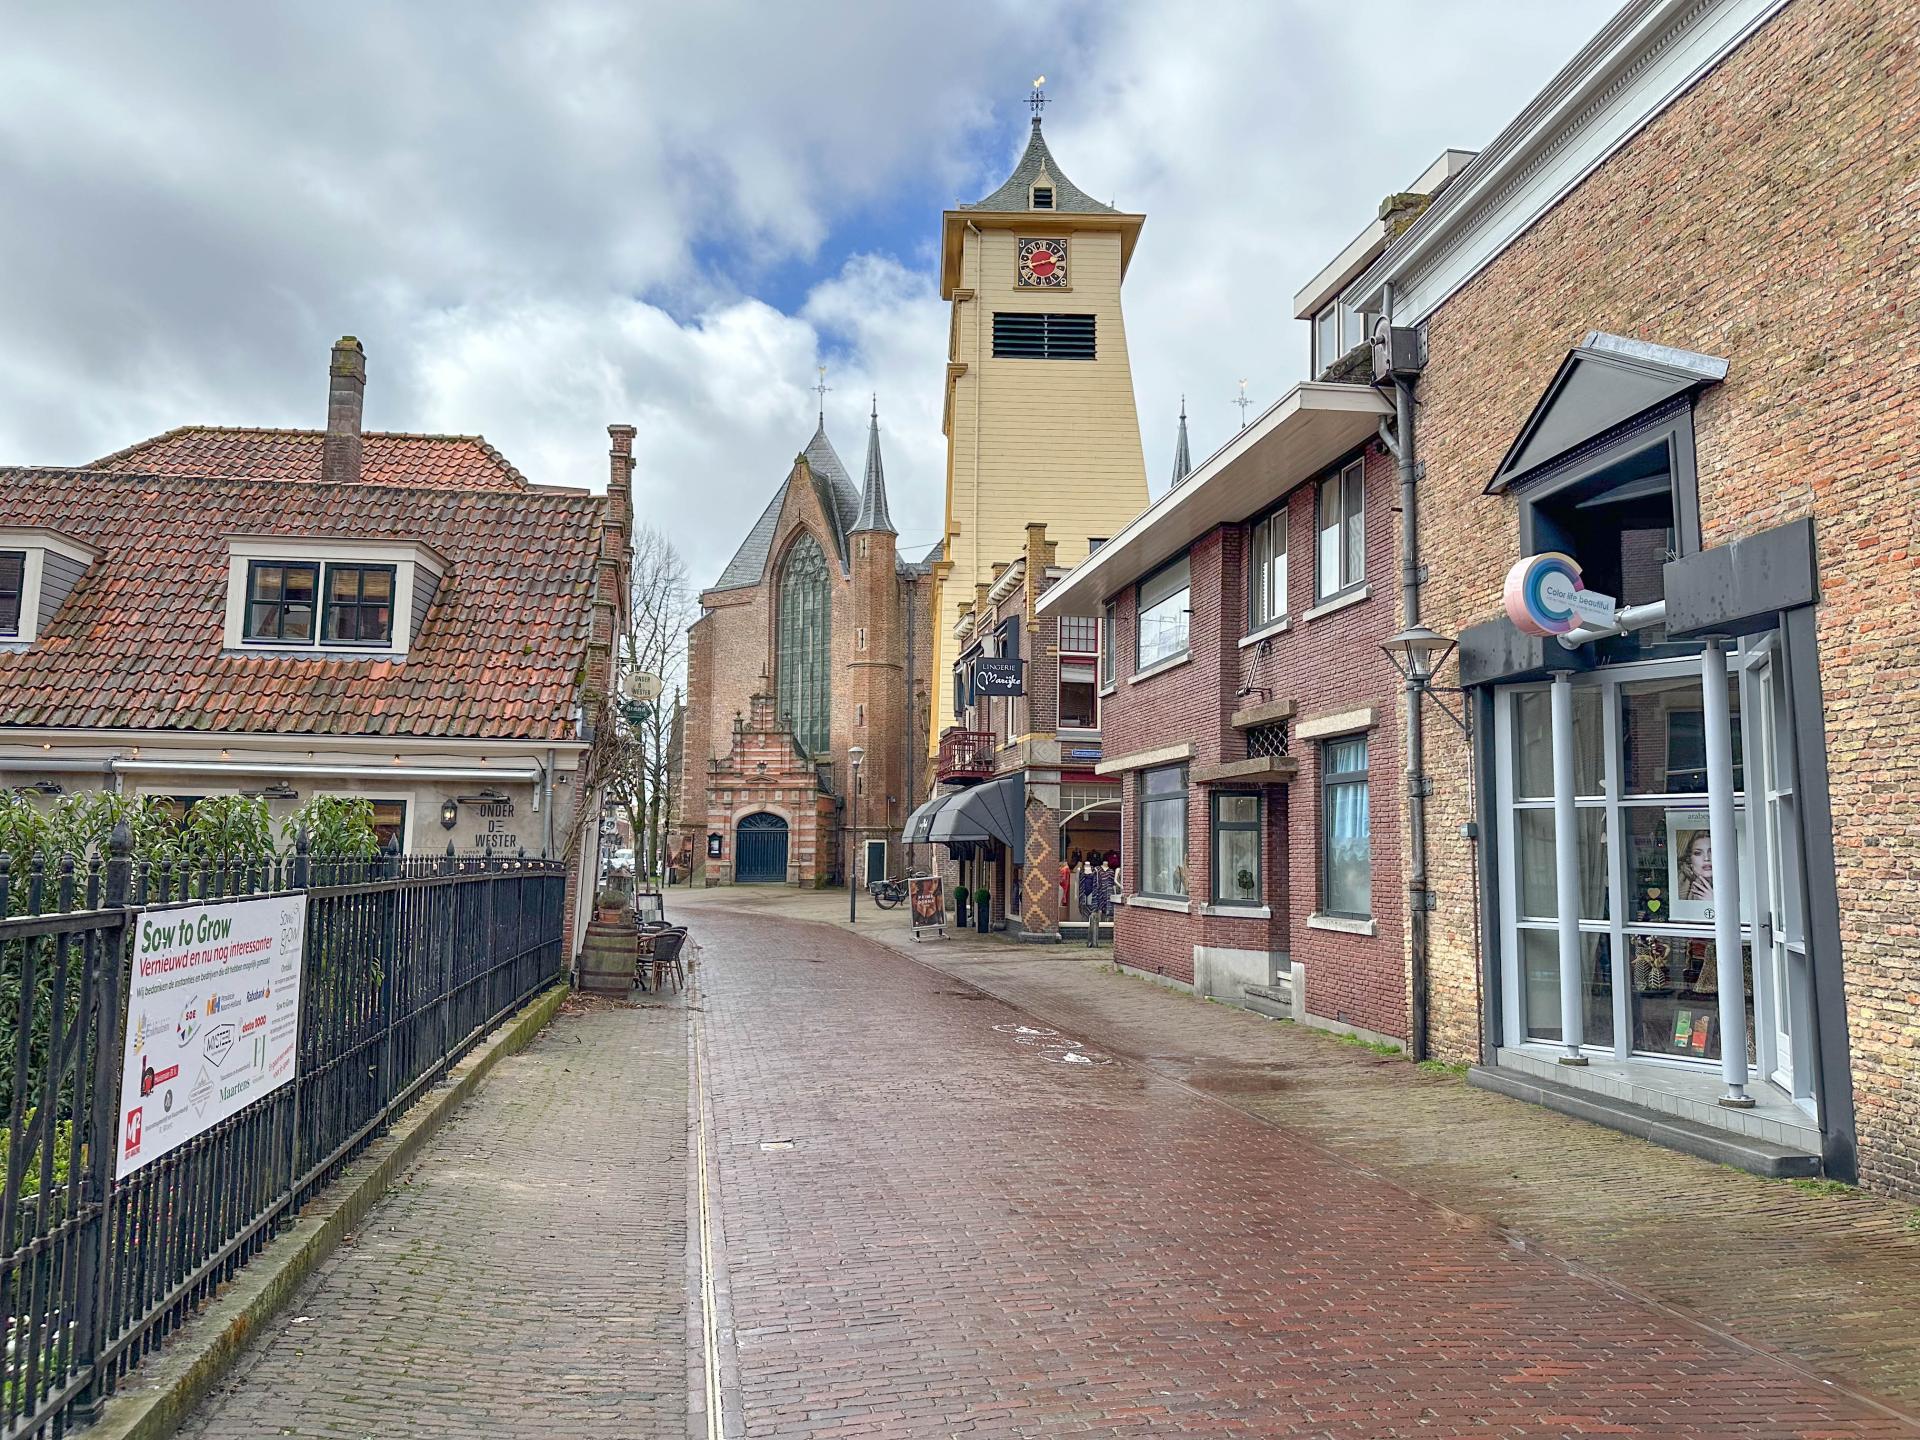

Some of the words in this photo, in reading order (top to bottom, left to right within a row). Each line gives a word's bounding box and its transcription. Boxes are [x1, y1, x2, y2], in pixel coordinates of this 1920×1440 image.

[1547, 586, 1566, 598] Color
[1567, 592, 1578, 602] life
[1579, 596, 1609, 611] beautiful
[982, 663, 1016, 671] LINGERIE
[976, 671, 1021, 690] Marijke
[480, 804, 515, 818] ONDER
[488, 820, 504, 833] DE
[475, 834, 517, 848] WESTER
[142, 920, 176, 953] Sow
[179, 919, 194, 946] to
[197, 913, 232, 943] Grow
[139, 949, 189, 977] Vernieuwd
[190, 951, 201, 967] en
[202, 949, 213, 965] nu
[214, 946, 229, 964] nog
[230, 936, 272, 957] interessanter
[246, 986, 265, 1002] Rabobank
[186, 1009, 197, 1021] SOE
[219, 1079, 251, 1104] Maartens
